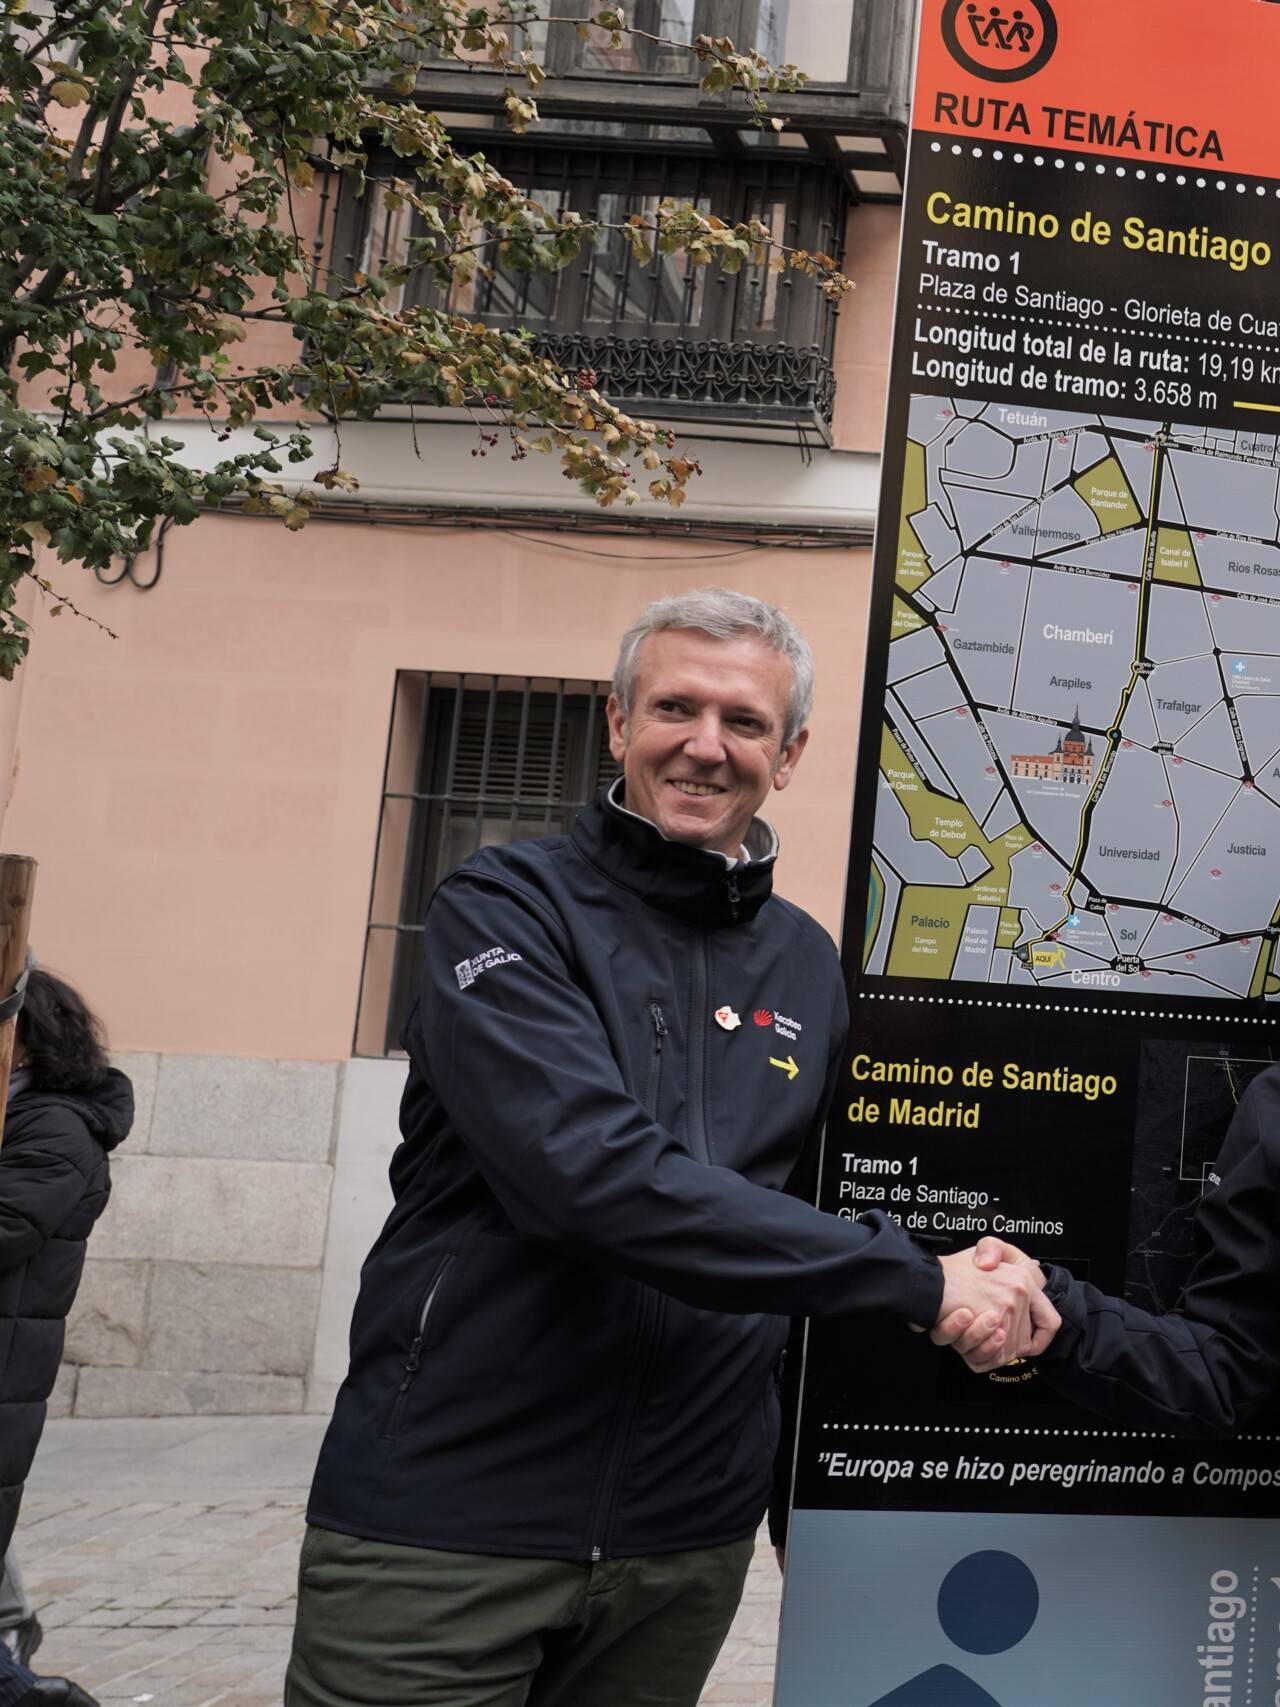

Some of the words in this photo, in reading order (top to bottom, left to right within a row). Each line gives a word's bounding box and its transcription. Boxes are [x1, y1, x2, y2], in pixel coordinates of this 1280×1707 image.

[934, 91, 1031, 135] RUTA
[1042, 106, 1224, 161] TEMÁTICA
[926, 192, 1059, 239] Camino
[1070, 211, 1112, 245] de
[1123, 216, 1271, 271] Santiago
[922, 240, 1000, 272] Tramo
[1009, 251, 1020, 275] 1
[919, 273, 976, 300] Plaza
[983, 282, 1008, 304] de
[1015, 285, 1104, 319] Santiago
[1124, 299, 1201, 327] Glorieta
[1208, 310, 1232, 332] de
[914, 318, 1016, 353] Longitud
[1023, 331, 1072, 360] total
[1079, 338, 1106, 364] de
[1113, 342, 1132, 367] la
[1139, 349, 1189, 373] ruta:
[1199, 352, 1254, 382] 19,19
[911, 351, 1014, 387] Longitud
[1014, 365, 1048, 390] de
[1054, 370, 1126, 399] tramo:
[1134, 378, 1191, 407] 3.658
[1199, 389, 1217, 410] m
[998, 407, 1048, 428] Tetuán
[1241, 439, 1273, 454] Cuatro
[1091, 487, 1117, 498] Parque
[1118, 490, 1128, 498] de
[1090, 499, 1128, 510] Santander
[1011, 524, 1081, 541] Vallehermoso
[1042, 623, 1114, 645] Chamberí
[953, 638, 1015, 655] Gaztambide
[1049, 675, 1092, 691] Arapiles
[1156, 698, 1202, 715] Trafalgar
[888, 768, 915, 779] Parque
[896, 781, 918, 791] Oeste
[935, 817, 964, 828] Templo
[929, 829, 940, 837] de
[941, 829, 966, 840] Debod
[1099, 846, 1160, 861] Universidad
[1227, 842, 1267, 857] Justicia
[911, 915, 950, 929] Palacio
[1183, 916, 1195, 927] Calle
[1201, 924, 1213, 935] Gran
[966, 927, 989, 935] Palacio
[1120, 929, 1138, 941] Sol
[914, 937, 937, 946] Campo
[923, 946, 939, 954] Moro
[965, 946, 986, 954] Madrid
[471, 946, 505, 967] XUNTA
[1117, 954, 1140, 964] Puerta
[472, 963, 485, 977] DE
[1115, 963, 1127, 972] del
[1128, 964, 1140, 973] Sol
[1071, 968, 1121, 986] Centro
[851, 1054, 953, 1086] Camino
[961, 1061, 994, 1088] de
[1001, 1063, 1117, 1101] Santiago
[847, 1096, 880, 1123] de
[889, 1098, 980, 1129] Madrid
[842, 1153, 902, 1175] Tramo
[909, 1156, 918, 1176] 1
[839, 1181, 885, 1200] Plaza
[890, 1183, 911, 1201] de
[916, 1185, 988, 1209] Santiago
[907, 1211, 928, 1229] de
[932, 1212, 988, 1232] Cuatro
[993, 1215, 1064, 1235] Caminos
[989, 1372, 1020, 1383] Camino
[1021, 1372, 1033, 1381] de
[920, 1460, 949, 1481] se
[955, 1456, 1005, 1481] hizo
[1010, 1459, 1166, 1488] peregrinando
[1171, 1466, 1185, 1484] a
[1197, 1569, 1247, 1707] antiago
